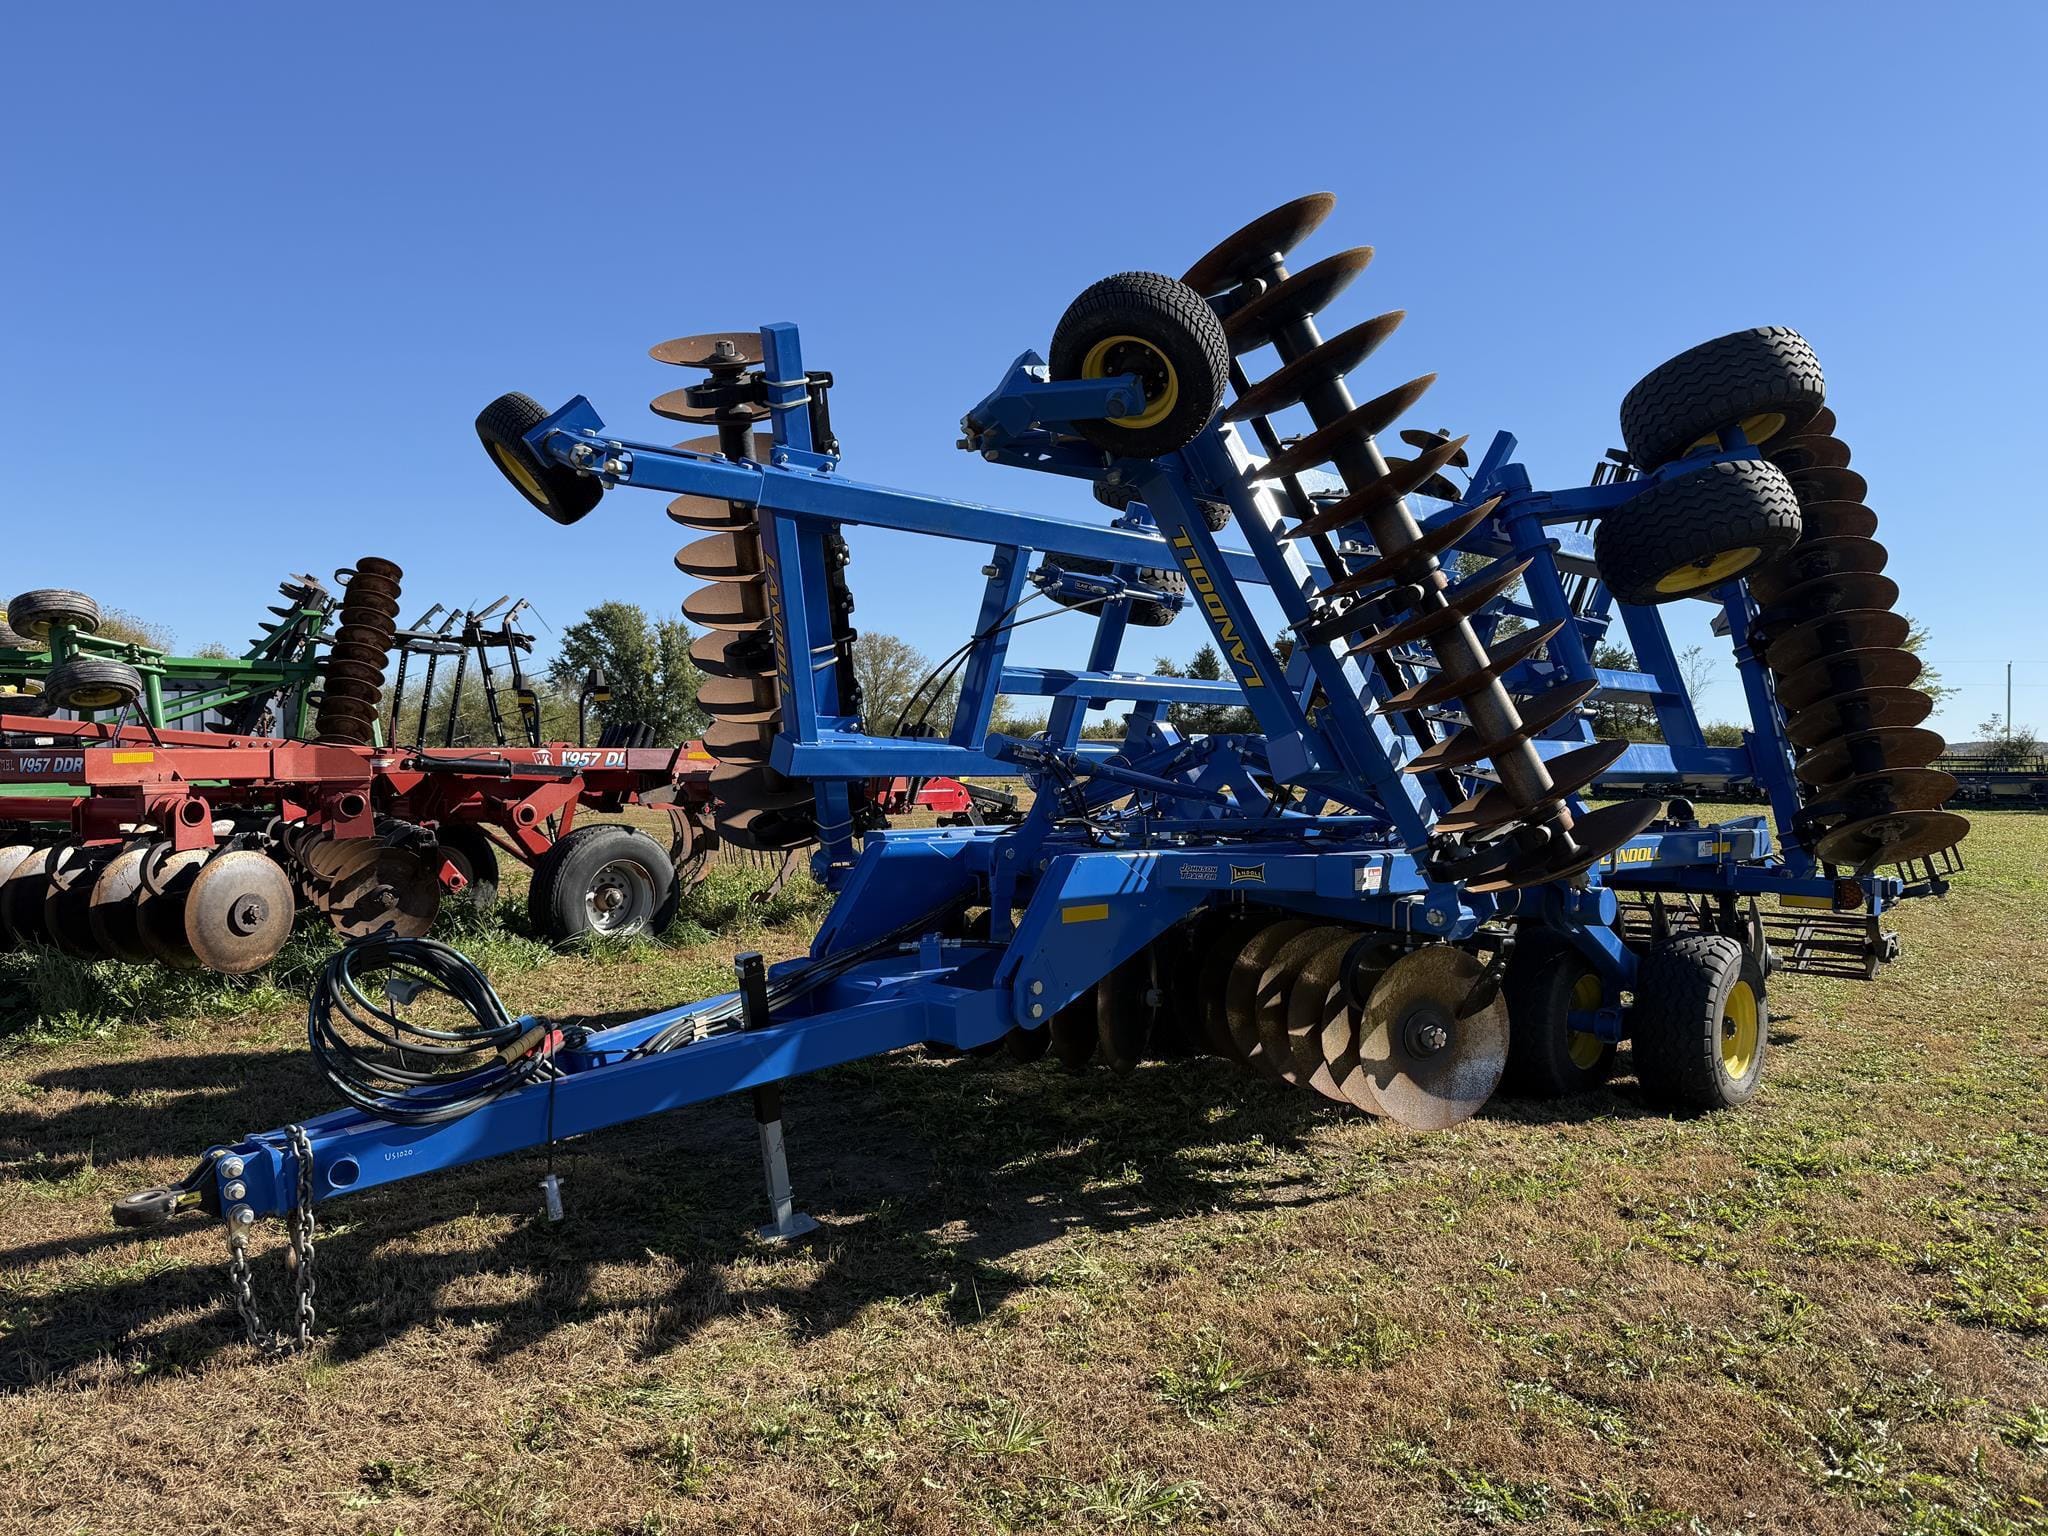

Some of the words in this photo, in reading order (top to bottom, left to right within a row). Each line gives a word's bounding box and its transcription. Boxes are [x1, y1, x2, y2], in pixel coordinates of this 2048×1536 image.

[1171, 525, 1265, 688] LANDOLL
[765, 553, 790, 696] LANDOLL
[19, 757, 51, 773] V957
[53, 757, 84, 773] DDR
[561, 751, 602, 767] V957
[1600, 847, 1662, 865] LNDOLL
